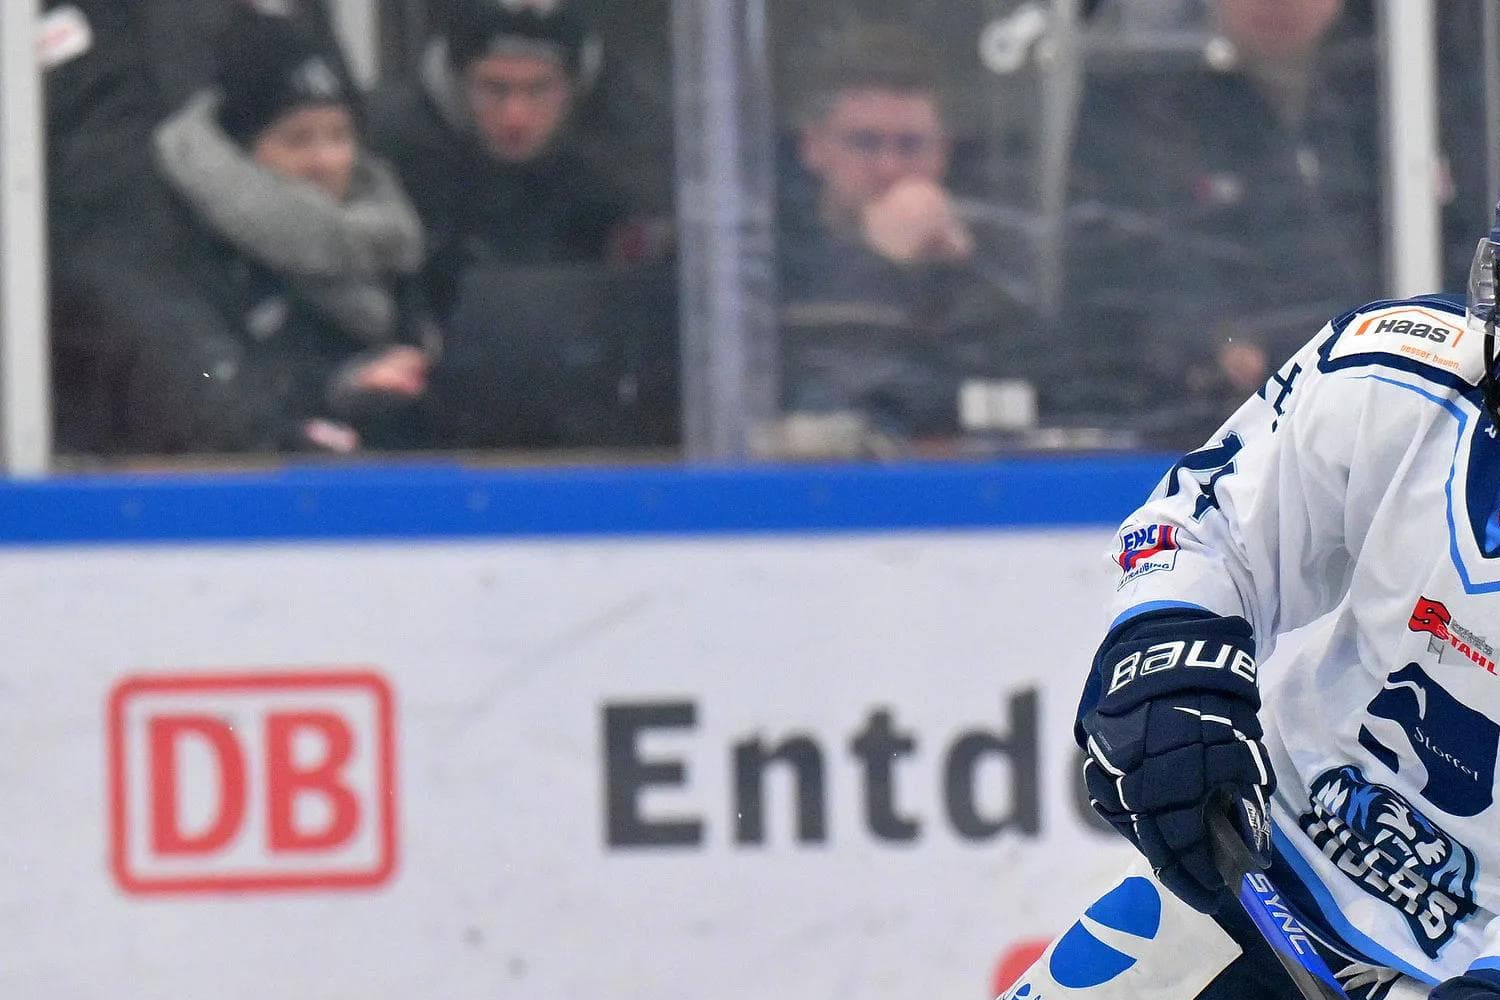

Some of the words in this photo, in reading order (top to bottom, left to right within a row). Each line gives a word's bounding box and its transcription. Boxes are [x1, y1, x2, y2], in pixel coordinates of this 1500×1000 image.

[1122, 523, 1159, 552] EHC
[147, 711, 363, 857] DB
[1244, 872, 1319, 956] SYNC
